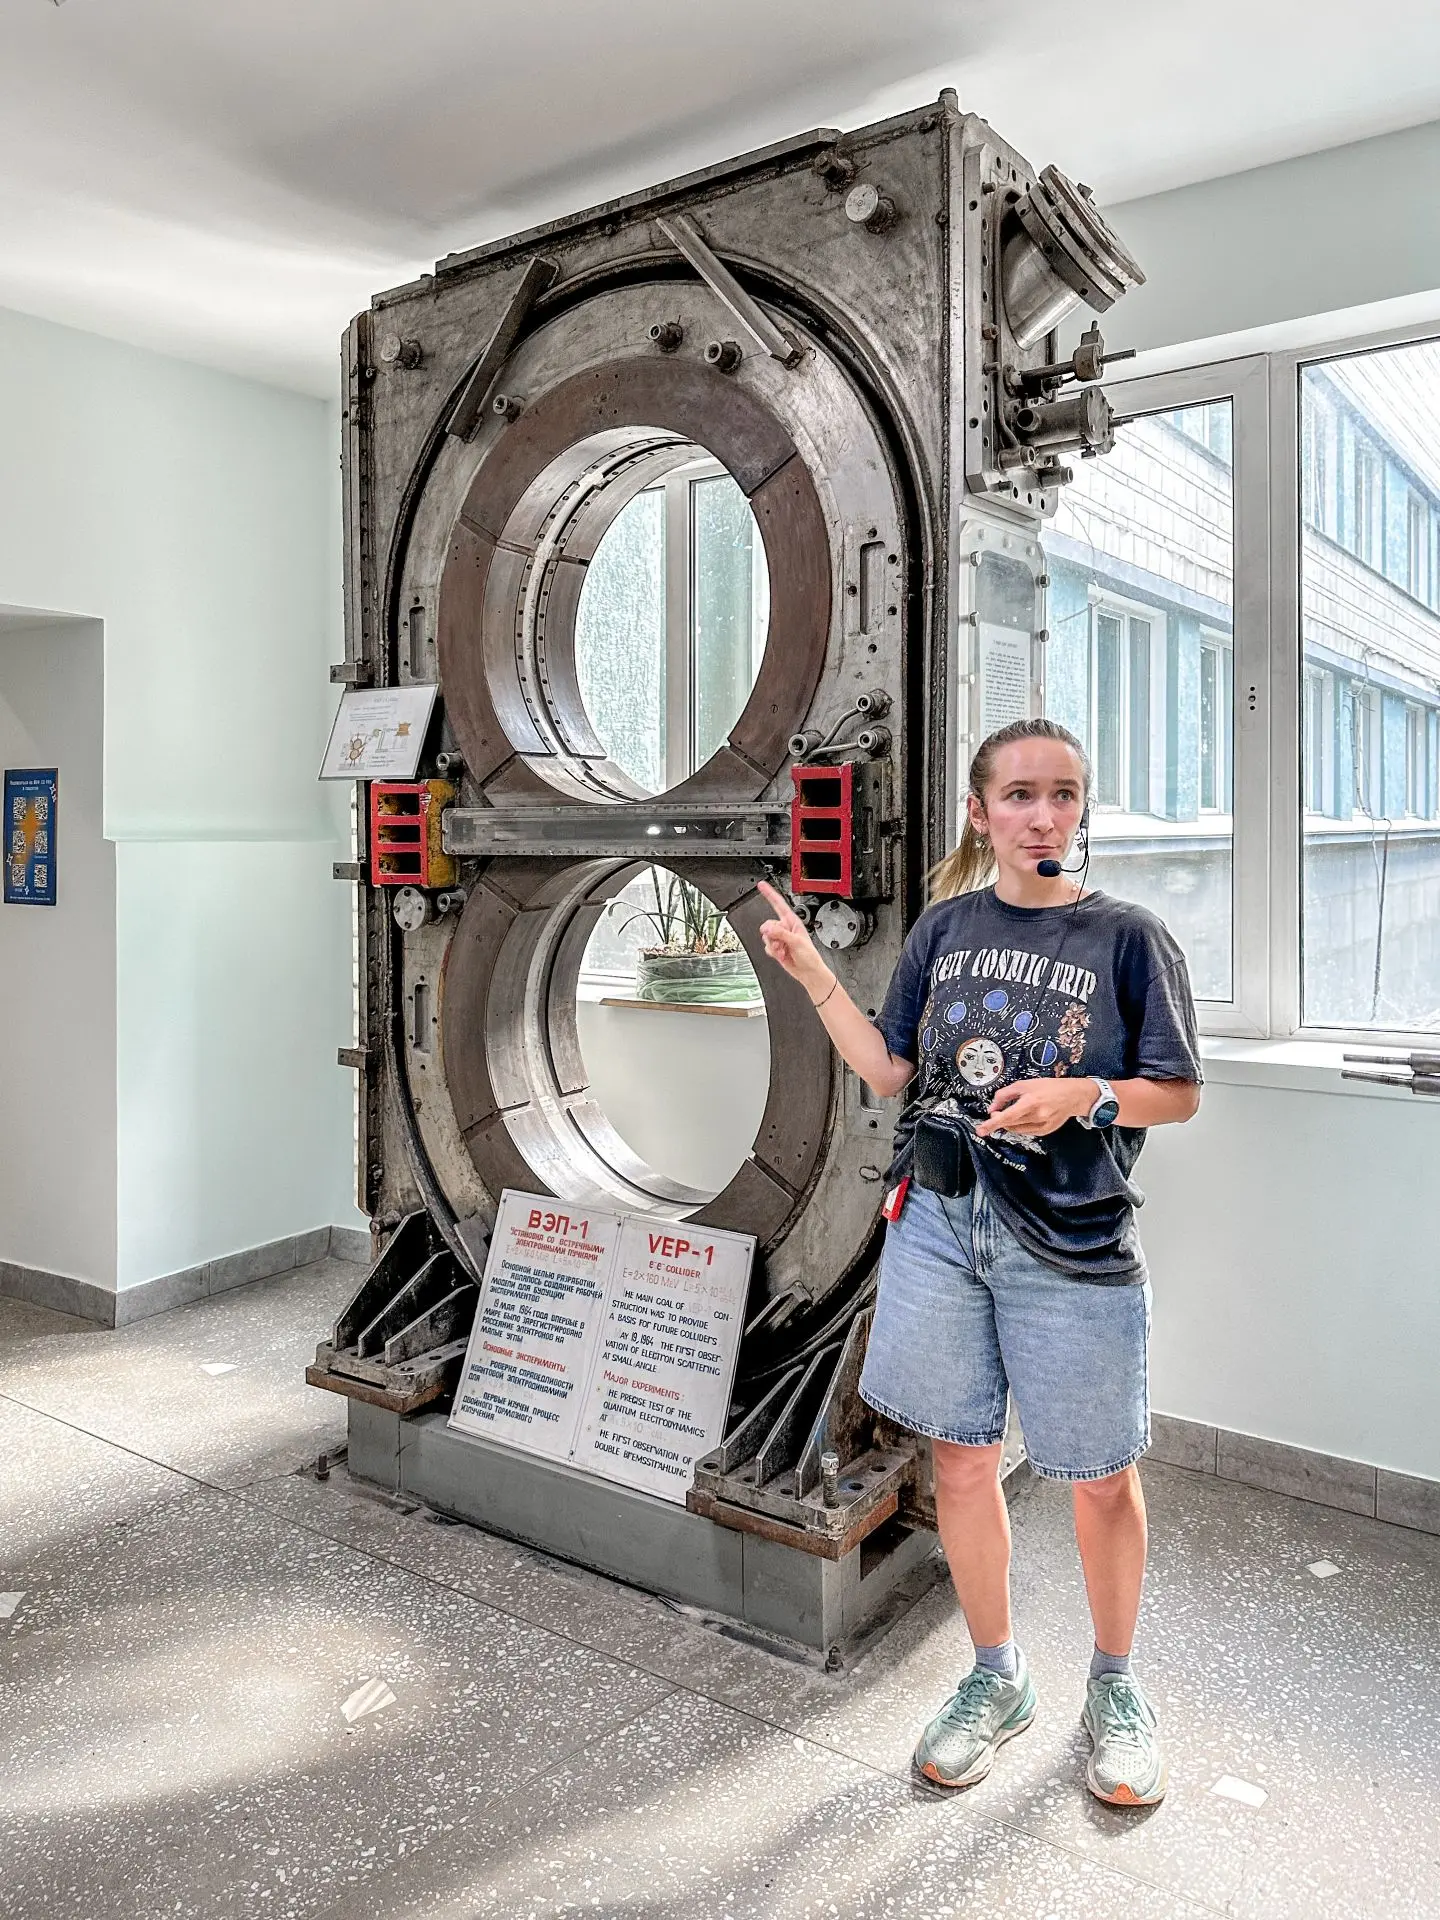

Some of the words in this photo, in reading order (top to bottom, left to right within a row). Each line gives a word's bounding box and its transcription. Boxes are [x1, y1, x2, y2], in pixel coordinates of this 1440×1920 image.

[972, 948, 1049, 987] COSMIC
[1047, 961, 1097, 1003] TRIP
[528, 1209, 589, 1239] ВЭП-1
[516, 1239, 566, 1255] ЭЛЕКТРОННЫМИ
[568, 1249, 598, 1262] ПУЧКАМИ
[648, 1233, 715, 1266] VEP-1
[665, 1264, 701, 1279] COLLIDER
[491, 1276, 516, 1288] МОДЕЛИ
[517, 1283, 531, 1291] ДЛЯ
[575, 1287, 603, 1300] РАБОЧЕЙ
[636, 1292, 654, 1304] MAIN
[675, 1302, 685, 1311] OF
[499, 1301, 515, 1311] МАЯ
[532, 1310, 549, 1321] ГОДА
[611, 1300, 648, 1315] STRUCTION
[650, 1308, 665, 1319] WAS
[668, 1313, 677, 1322] TO
[678, 1315, 709, 1330] PROVIDE
[484, 1307, 500, 1318] МИРЕ
[503, 1312, 520, 1322] БЫЛО
[522, 1316, 583, 1339] ЗАРЕГИСТРИРОВАНО
[608, 1312, 615, 1321] A
[617, 1314, 637, 1326] BASIS
[652, 1323, 679, 1336] FUTURE
[481, 1325, 503, 1338] МАЛЫЕ
[506, 1333, 524, 1343] УГЛЫ
[555, 1335, 565, 1344] НА
[605, 1339, 629, 1352] VATION
[630, 1346, 639, 1355] OF
[660, 1341, 674, 1352] THE
[602, 1351, 611, 1359] AT
[611, 1353, 633, 1366] SMALL
[468, 1372, 481, 1382] ДЛЯ
[519, 1368, 574, 1391] СПРАВЕДЛИВОСТИ
[603, 1370, 629, 1386] MAJOR
[462, 1395, 493, 1410] ДВОЙНОГО
[495, 1404, 533, 1424] ТОРМОЗНОГО
[507, 1399, 530, 1412] ИЗУЧЕН
[532, 1407, 560, 1422] ПРОЦЕСС
[603, 1401, 637, 1418] QUANTUM
[620, 1392, 646, 1407] PRECISE
[648, 1400, 664, 1413] TEST
[665, 1406, 676, 1415] OF
[678, 1409, 692, 1421] THE
[599, 1413, 608, 1422] AT
[594, 1440, 620, 1456] DOUBLE
[682, 1455, 693, 1465] OF
